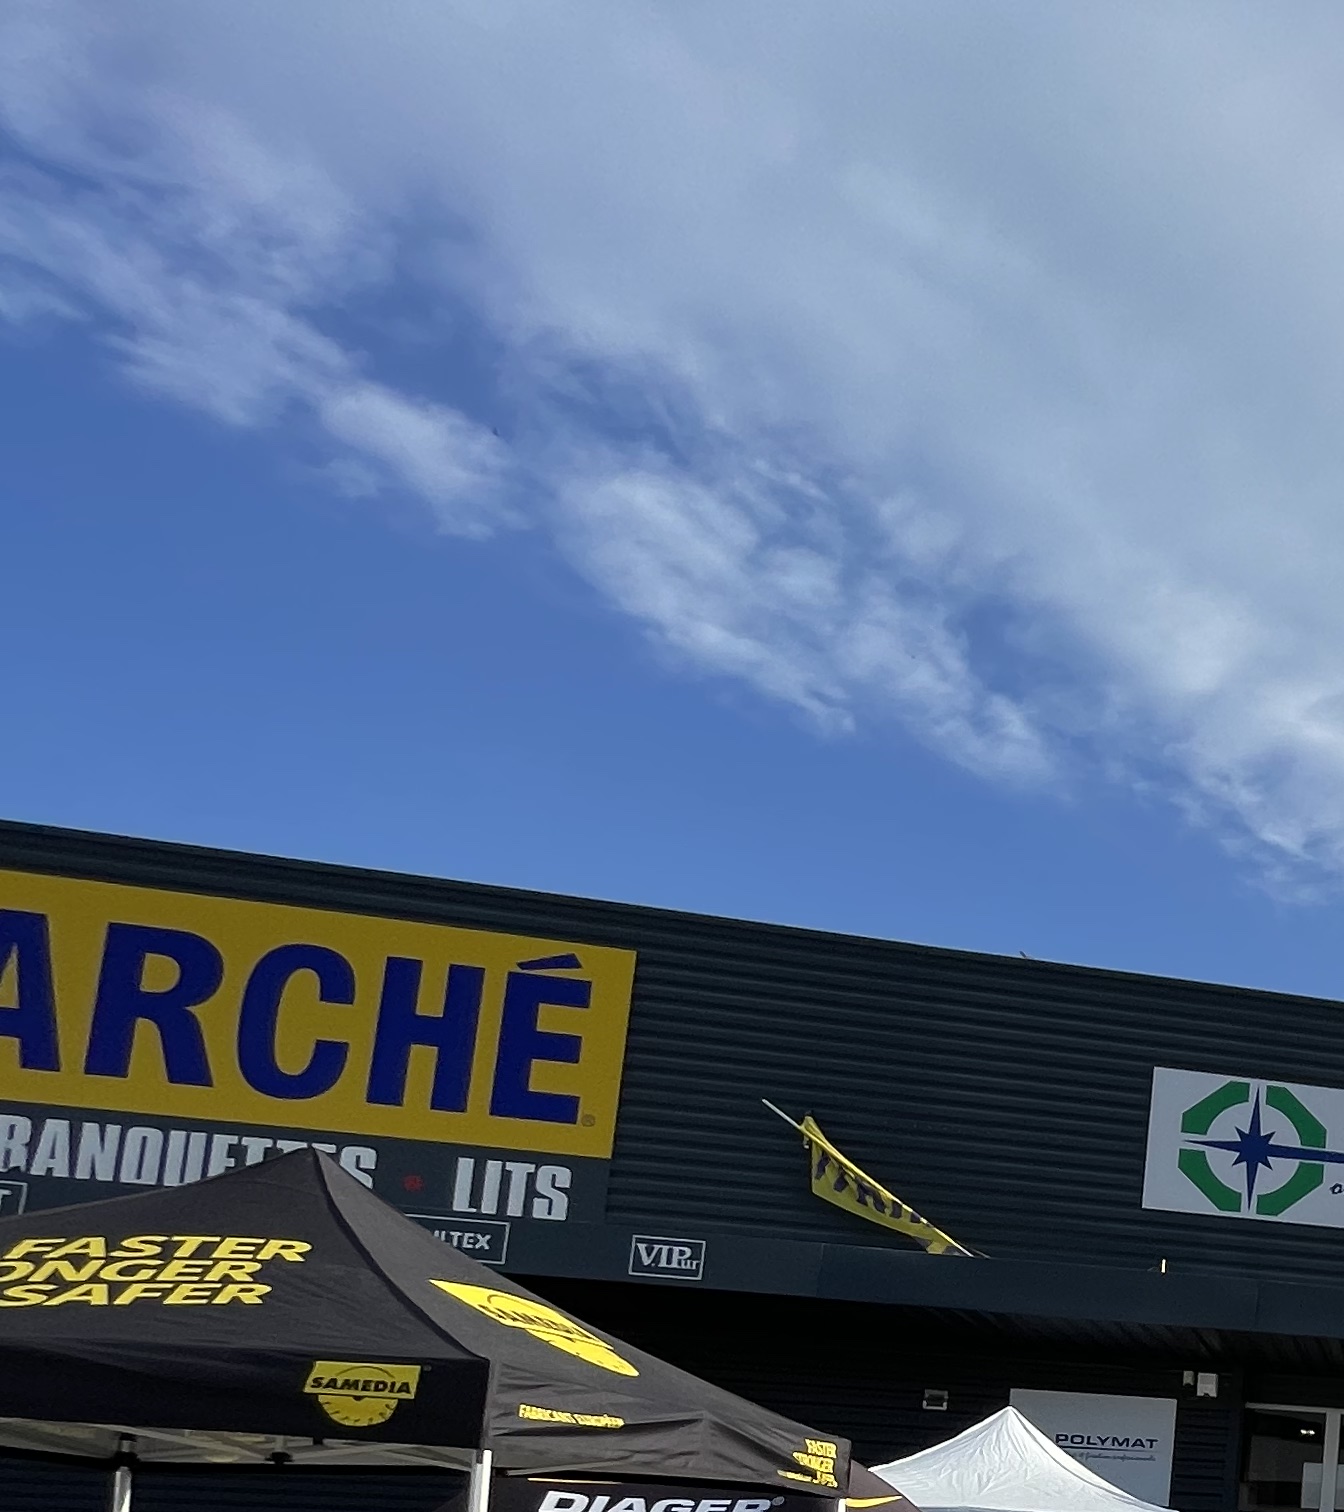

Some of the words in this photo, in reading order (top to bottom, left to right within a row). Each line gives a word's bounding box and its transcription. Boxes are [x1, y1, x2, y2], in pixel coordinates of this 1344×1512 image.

[453, 1157, 572, 1221] LITS
[4, 1234, 313, 1263] FASTER
[0, 1282, 273, 1307] SAFER
[310, 1375, 413, 1396] SAMEDIA
[1055, 1433, 1159, 1449] POLYMAT
